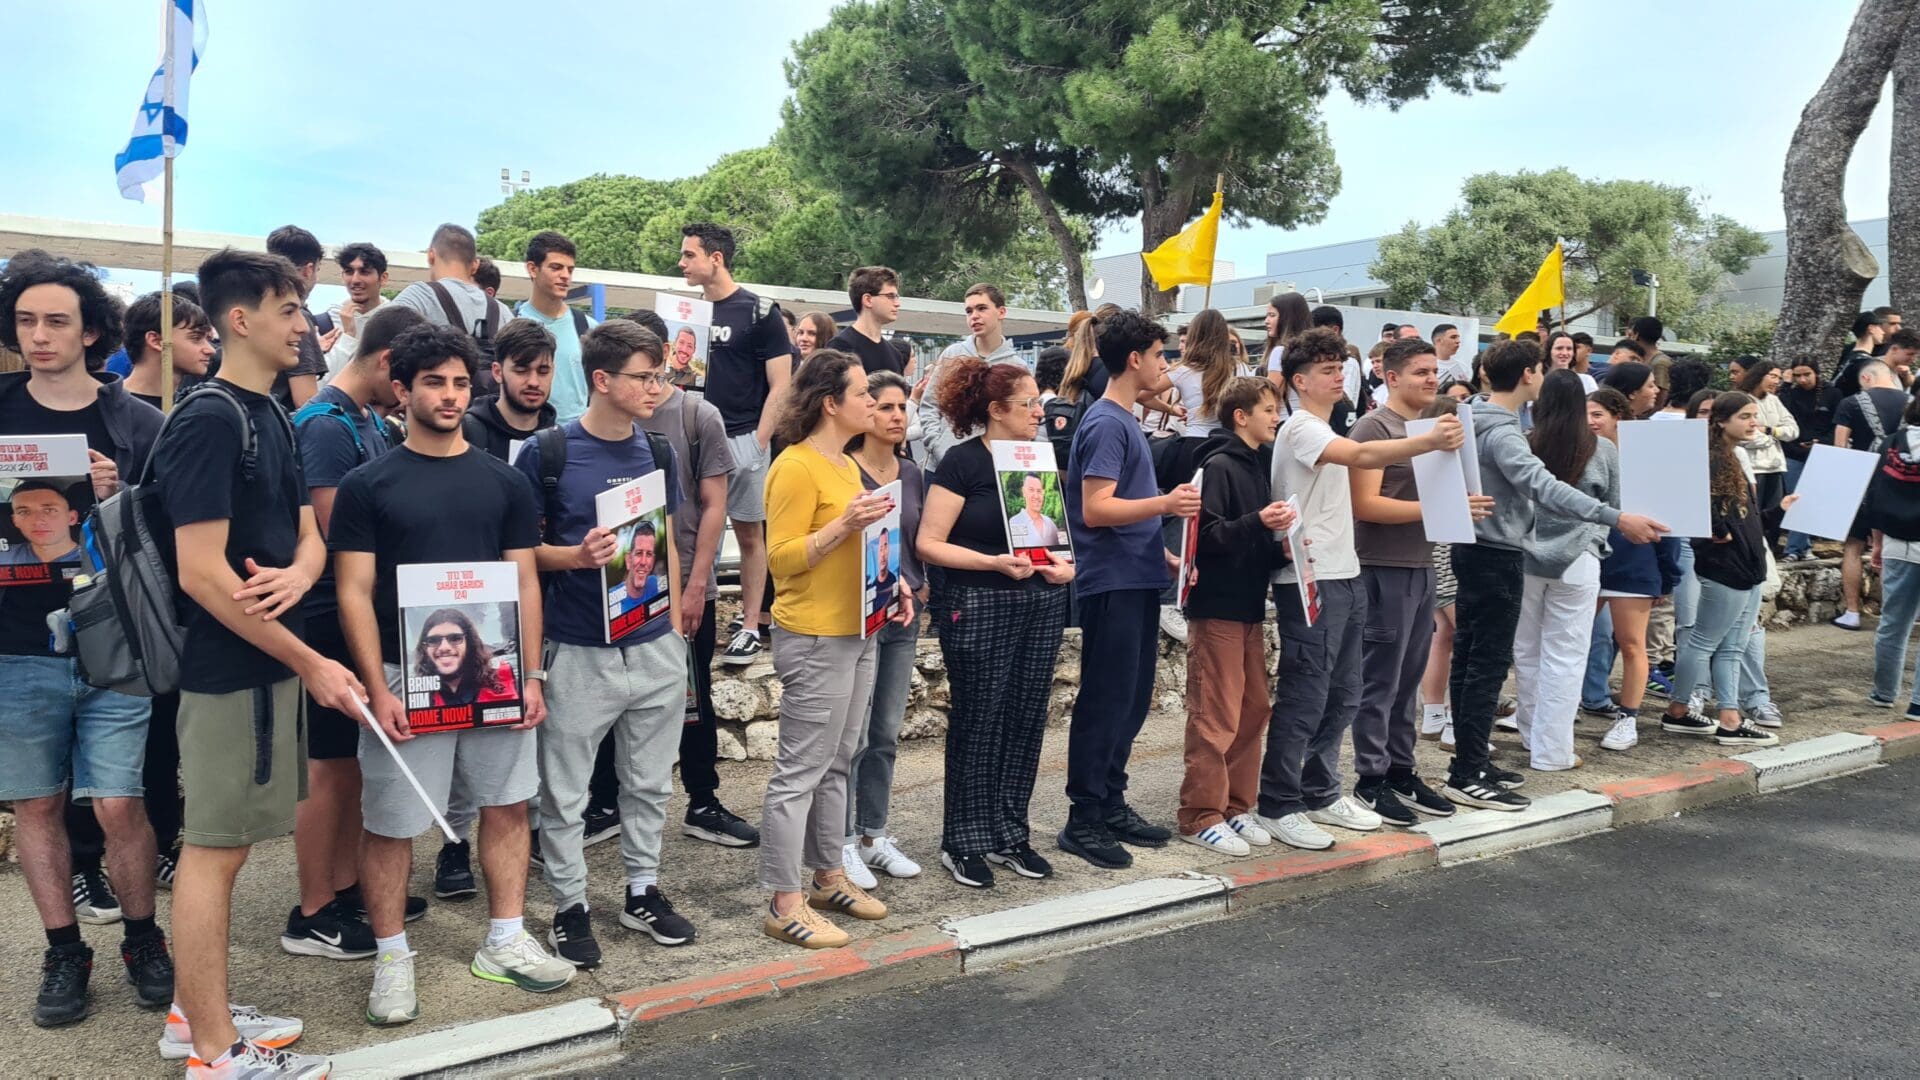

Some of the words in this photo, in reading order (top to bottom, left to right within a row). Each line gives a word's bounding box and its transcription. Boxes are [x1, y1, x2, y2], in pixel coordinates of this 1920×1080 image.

[15, 563, 50, 579] NOW!
[436, 581, 458, 591] SAHAR
[459, 579, 484, 590] BARUCH
[408, 675, 441, 693] BRING
[408, 692, 430, 709] HIM
[409, 709, 440, 727] HOME
[442, 704, 473, 723] NOW!
